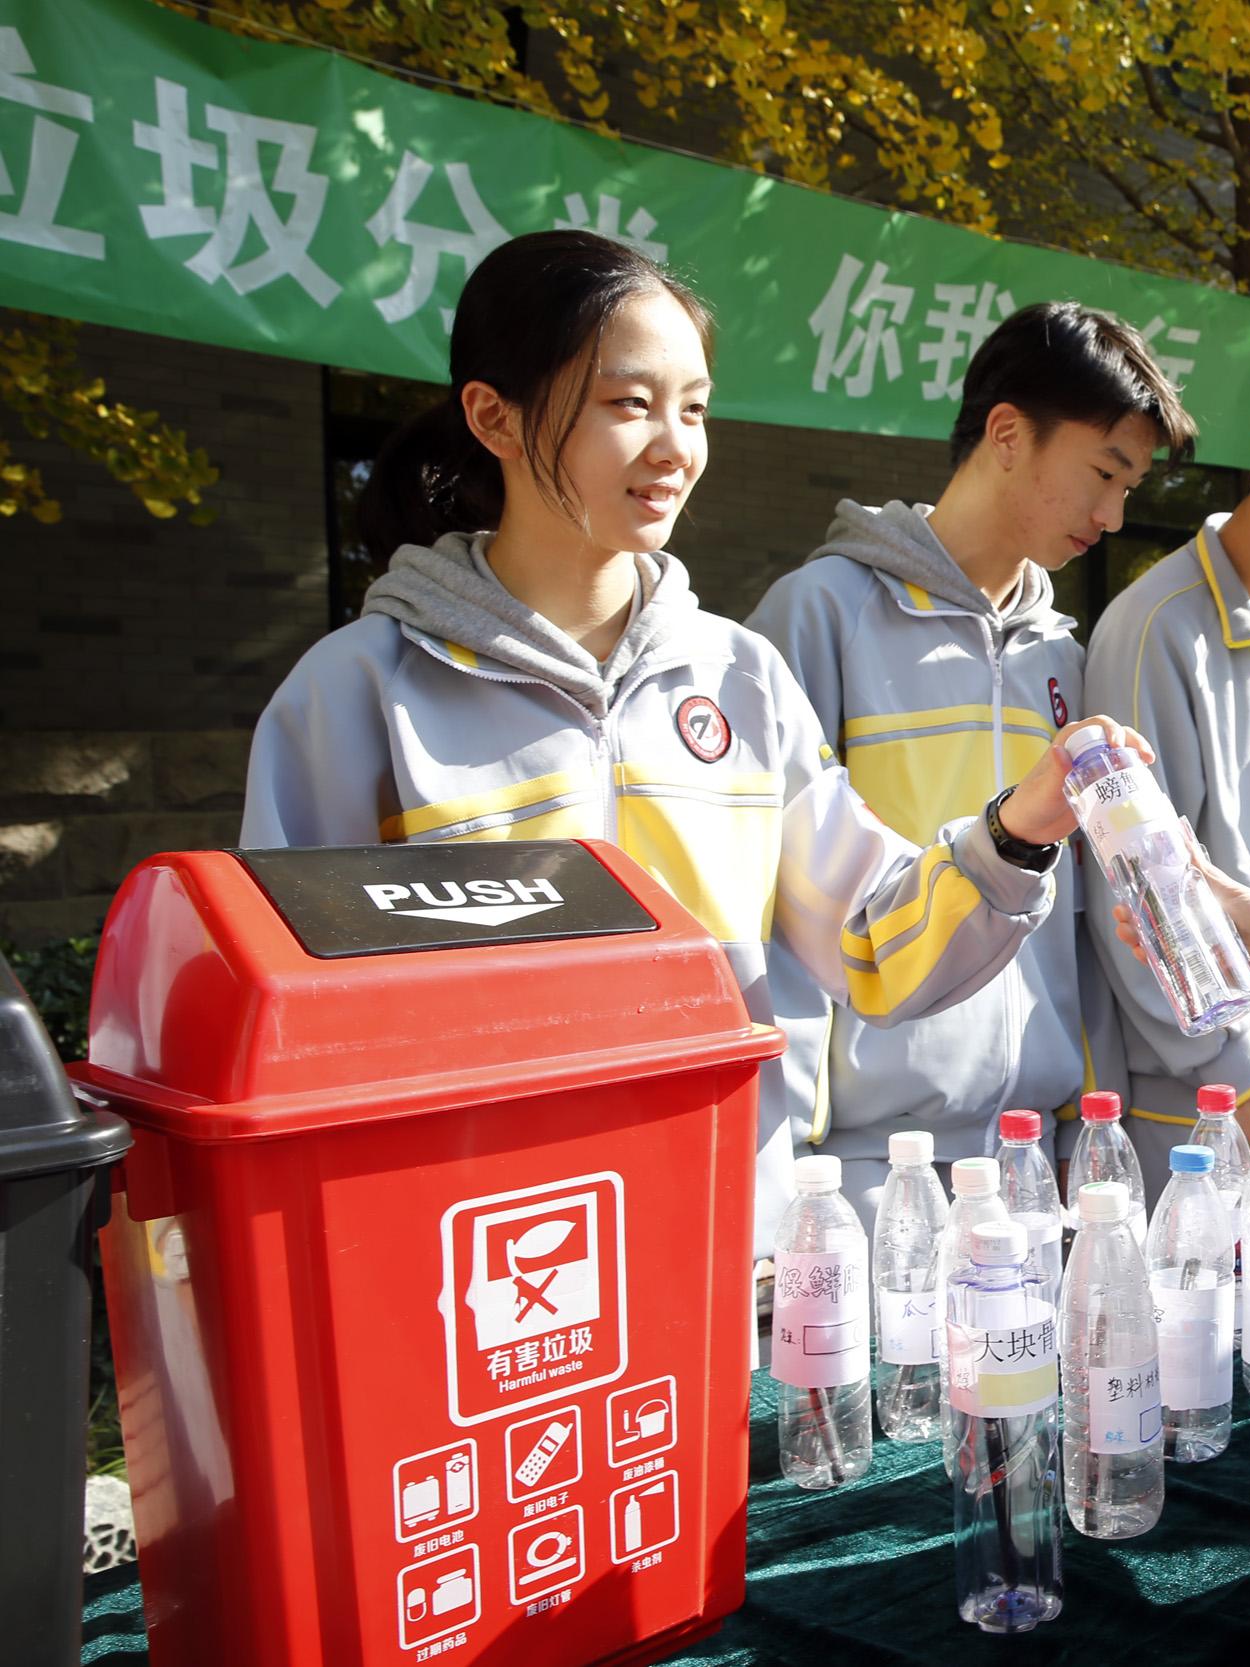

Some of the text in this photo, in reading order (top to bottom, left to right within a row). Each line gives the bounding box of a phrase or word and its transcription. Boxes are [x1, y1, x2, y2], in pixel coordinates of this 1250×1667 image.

[808, 252, 1201, 402] 你我行
[363, 878, 565, 911] PUSH
[487, 1326, 594, 1380] 有害垃圾
[499, 1360, 583, 1393] Harmful waste
[523, 1491, 569, 1518] 废旧电子
[413, 1529, 465, 1558] 废旧电池
[631, 1551, 663, 1573] 杀虫剂
[526, 1589, 572, 1617] 废旧灯管
[416, 1632, 468, 1663] 过期药品
